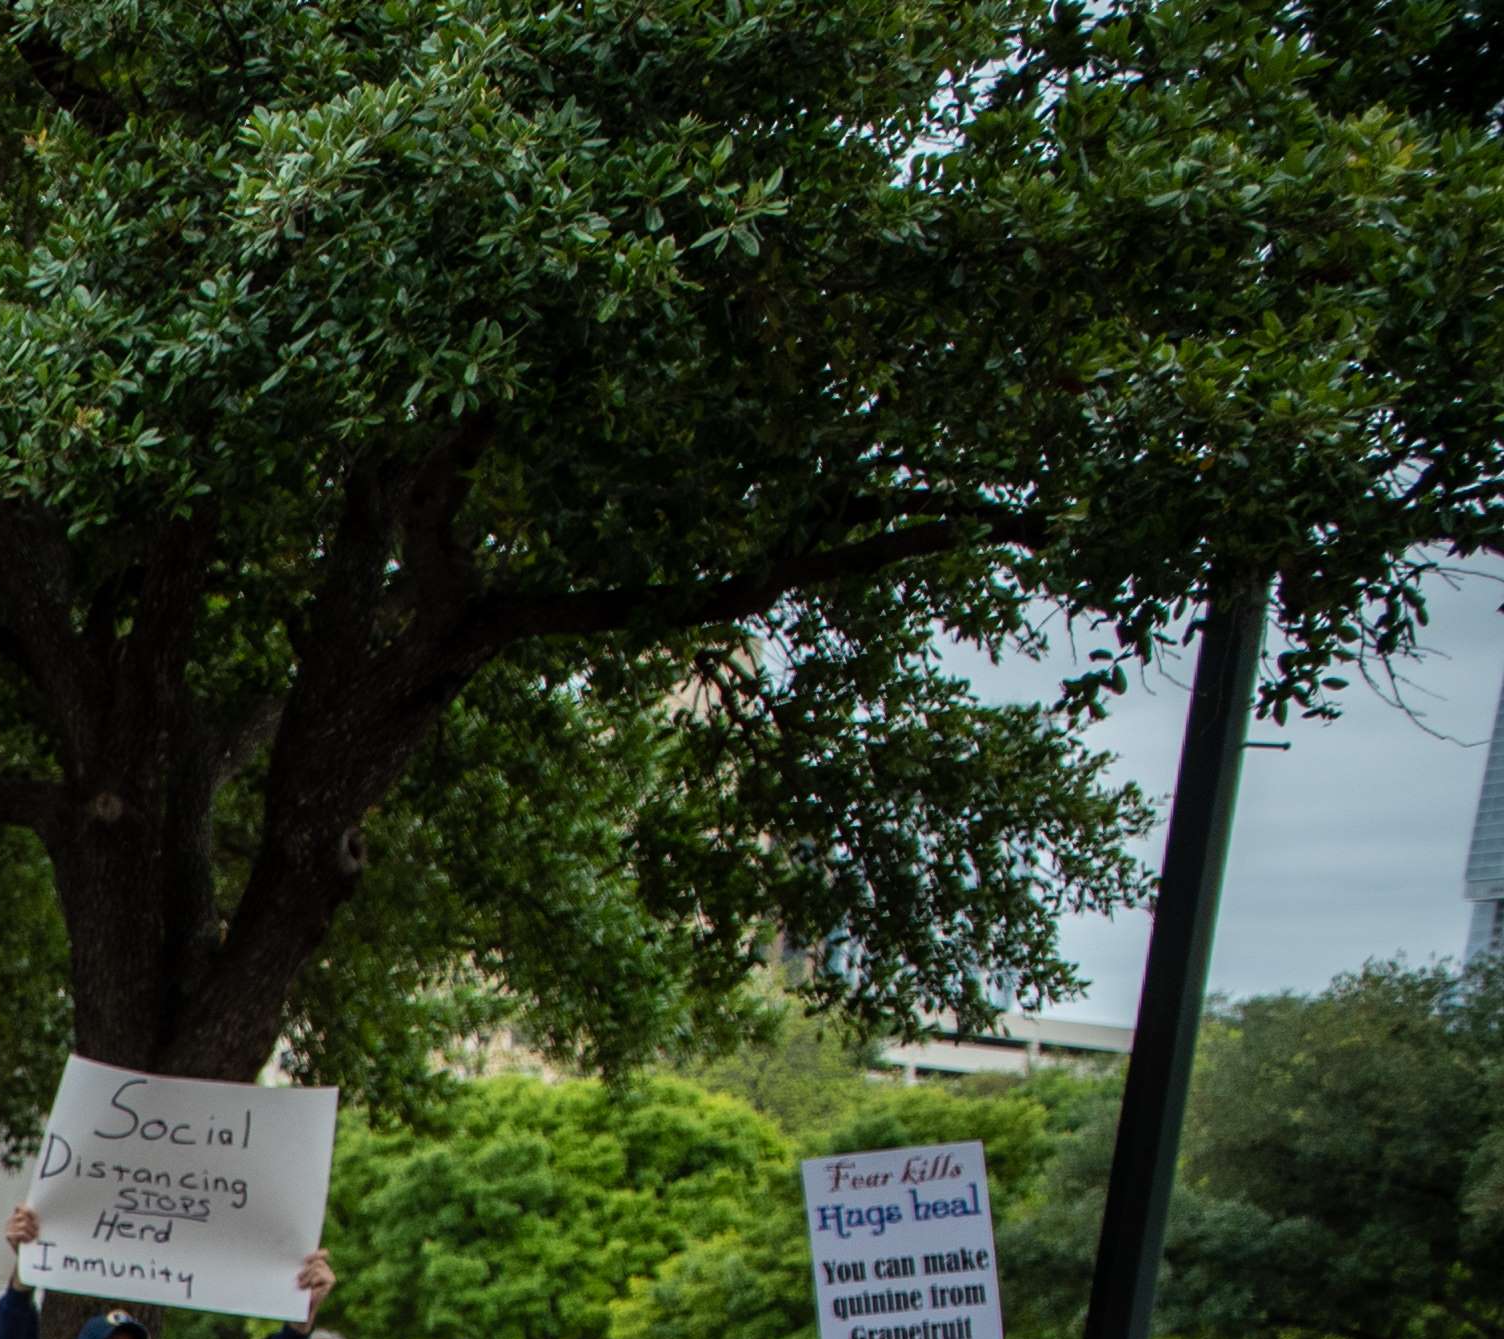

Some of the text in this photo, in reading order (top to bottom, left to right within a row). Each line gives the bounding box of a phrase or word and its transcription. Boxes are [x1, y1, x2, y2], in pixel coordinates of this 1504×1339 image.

[94, 1080, 250, 1148] Social
[40, 1133, 247, 1209] Distancing
[826, 1160, 892, 1192] Fear
[114, 1188, 210, 1217] STOPS
[816, 1182, 981, 1239] Hugs heal
[92, 1209, 172, 1243] Herd
[33, 1241, 193, 1298] Immunity
[823, 1247, 989, 1285] You can make
[833, 1282, 986, 1319] quinine from
